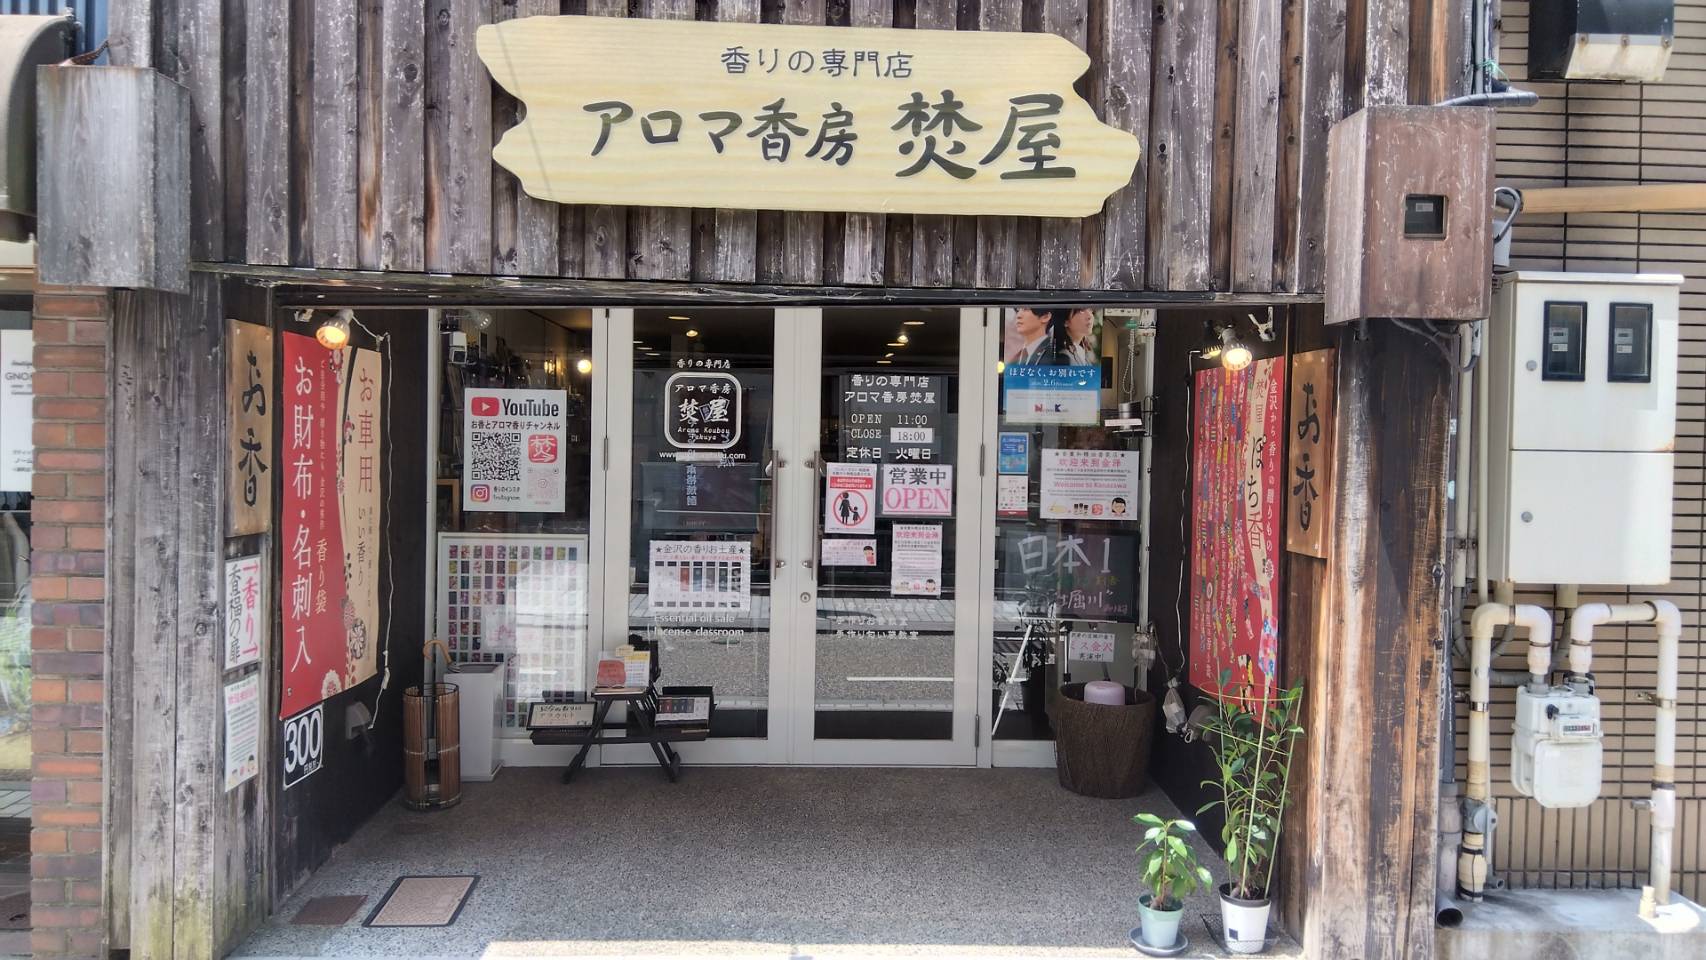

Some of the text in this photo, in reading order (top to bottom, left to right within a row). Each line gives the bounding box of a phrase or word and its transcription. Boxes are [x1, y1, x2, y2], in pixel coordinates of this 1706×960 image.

[720, 46, 914, 79] 香りの専門店
[582, 90, 1077, 181] アロマ香房 焚屋
[676, 358, 731, 369] 香りの専門店
[5, 372, 32, 381] GNO
[1009, 367, 1096, 377] ほどなく、お別れです
[674, 383, 732, 395] アロマ香房
[851, 374, 930, 388] 香りの専門店
[844, 391, 936, 404] アロマ香房焚屋
[502, 398, 559, 417] YouTube
[678, 397, 730, 423] 焚屋
[471, 420, 560, 431] お香とアロマ香りチャンネル
[851, 414, 928, 425] OPEN 11:00
[238, 350, 269, 507] お香
[357, 367, 374, 494] お車用
[850, 429, 926, 441] CLOSE 18:00
[846, 446, 931, 460] 定休日 火曜日
[1293, 381, 1320, 532] お香
[1266, 378, 1279, 552] 金沢から香りの贈りもの
[889, 467, 947, 486] 営業中
[885, 487, 951, 510] OPEN
[291, 356, 314, 673] お財布・名刺入
[663, 544, 737, 554] 金沢の香りお土産
[315, 538, 328, 614] 香り袋
[654, 613, 697, 623] Essential
[695, 626, 744, 637] classroom
[285, 710, 320, 773] 300
